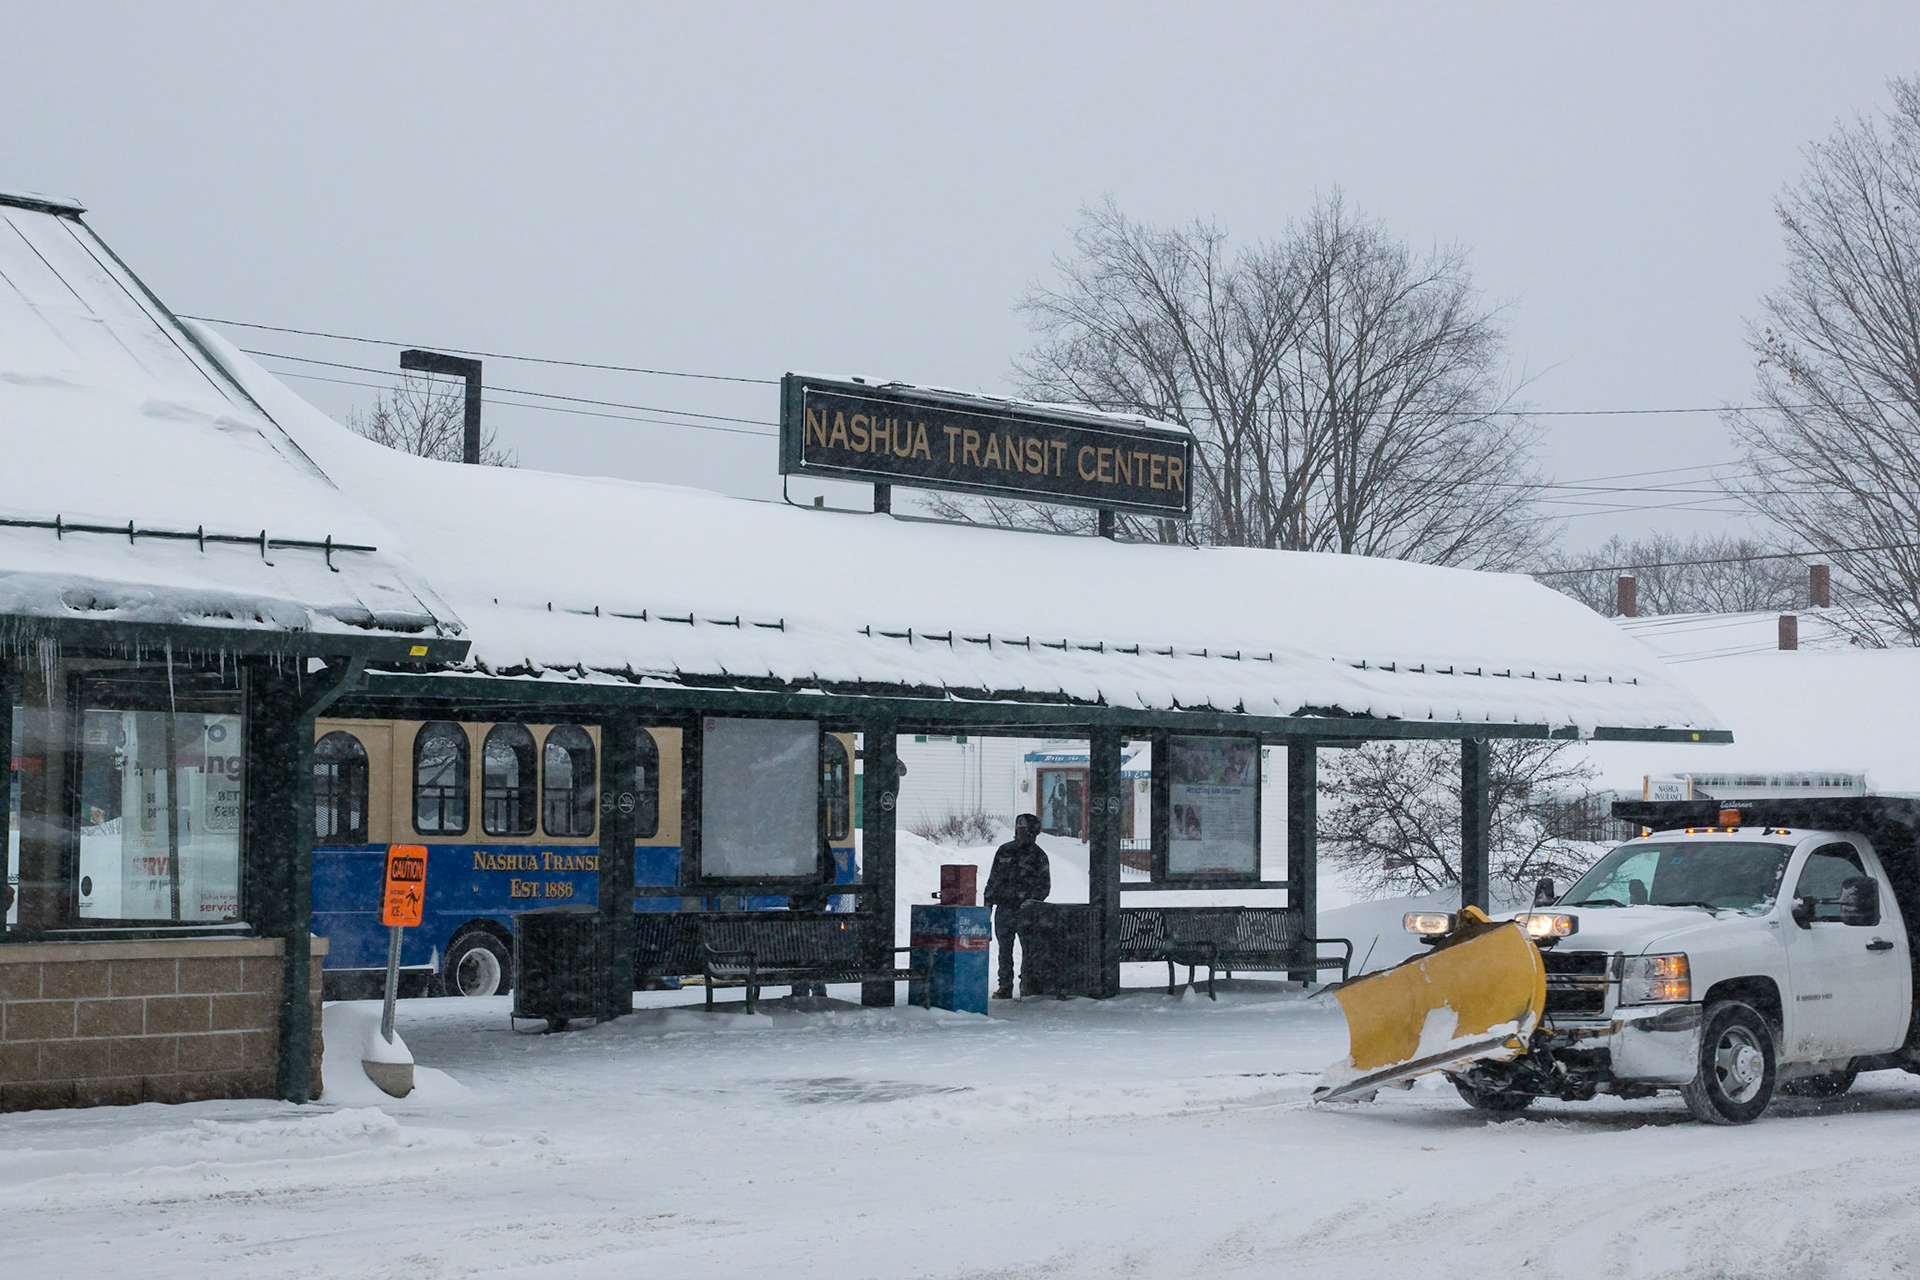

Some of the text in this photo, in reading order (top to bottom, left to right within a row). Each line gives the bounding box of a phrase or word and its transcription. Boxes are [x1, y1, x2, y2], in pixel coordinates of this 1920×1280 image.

[805, 408, 1184, 491] NASHUA TRANSIT CENTER
[1655, 793, 1683, 801] INSURANCE
[1658, 785, 1679, 793] NASHUA
[391, 860, 423, 879] CAUTION
[541, 852, 599, 871] TRANSI
[545, 882, 574, 898] 1886
